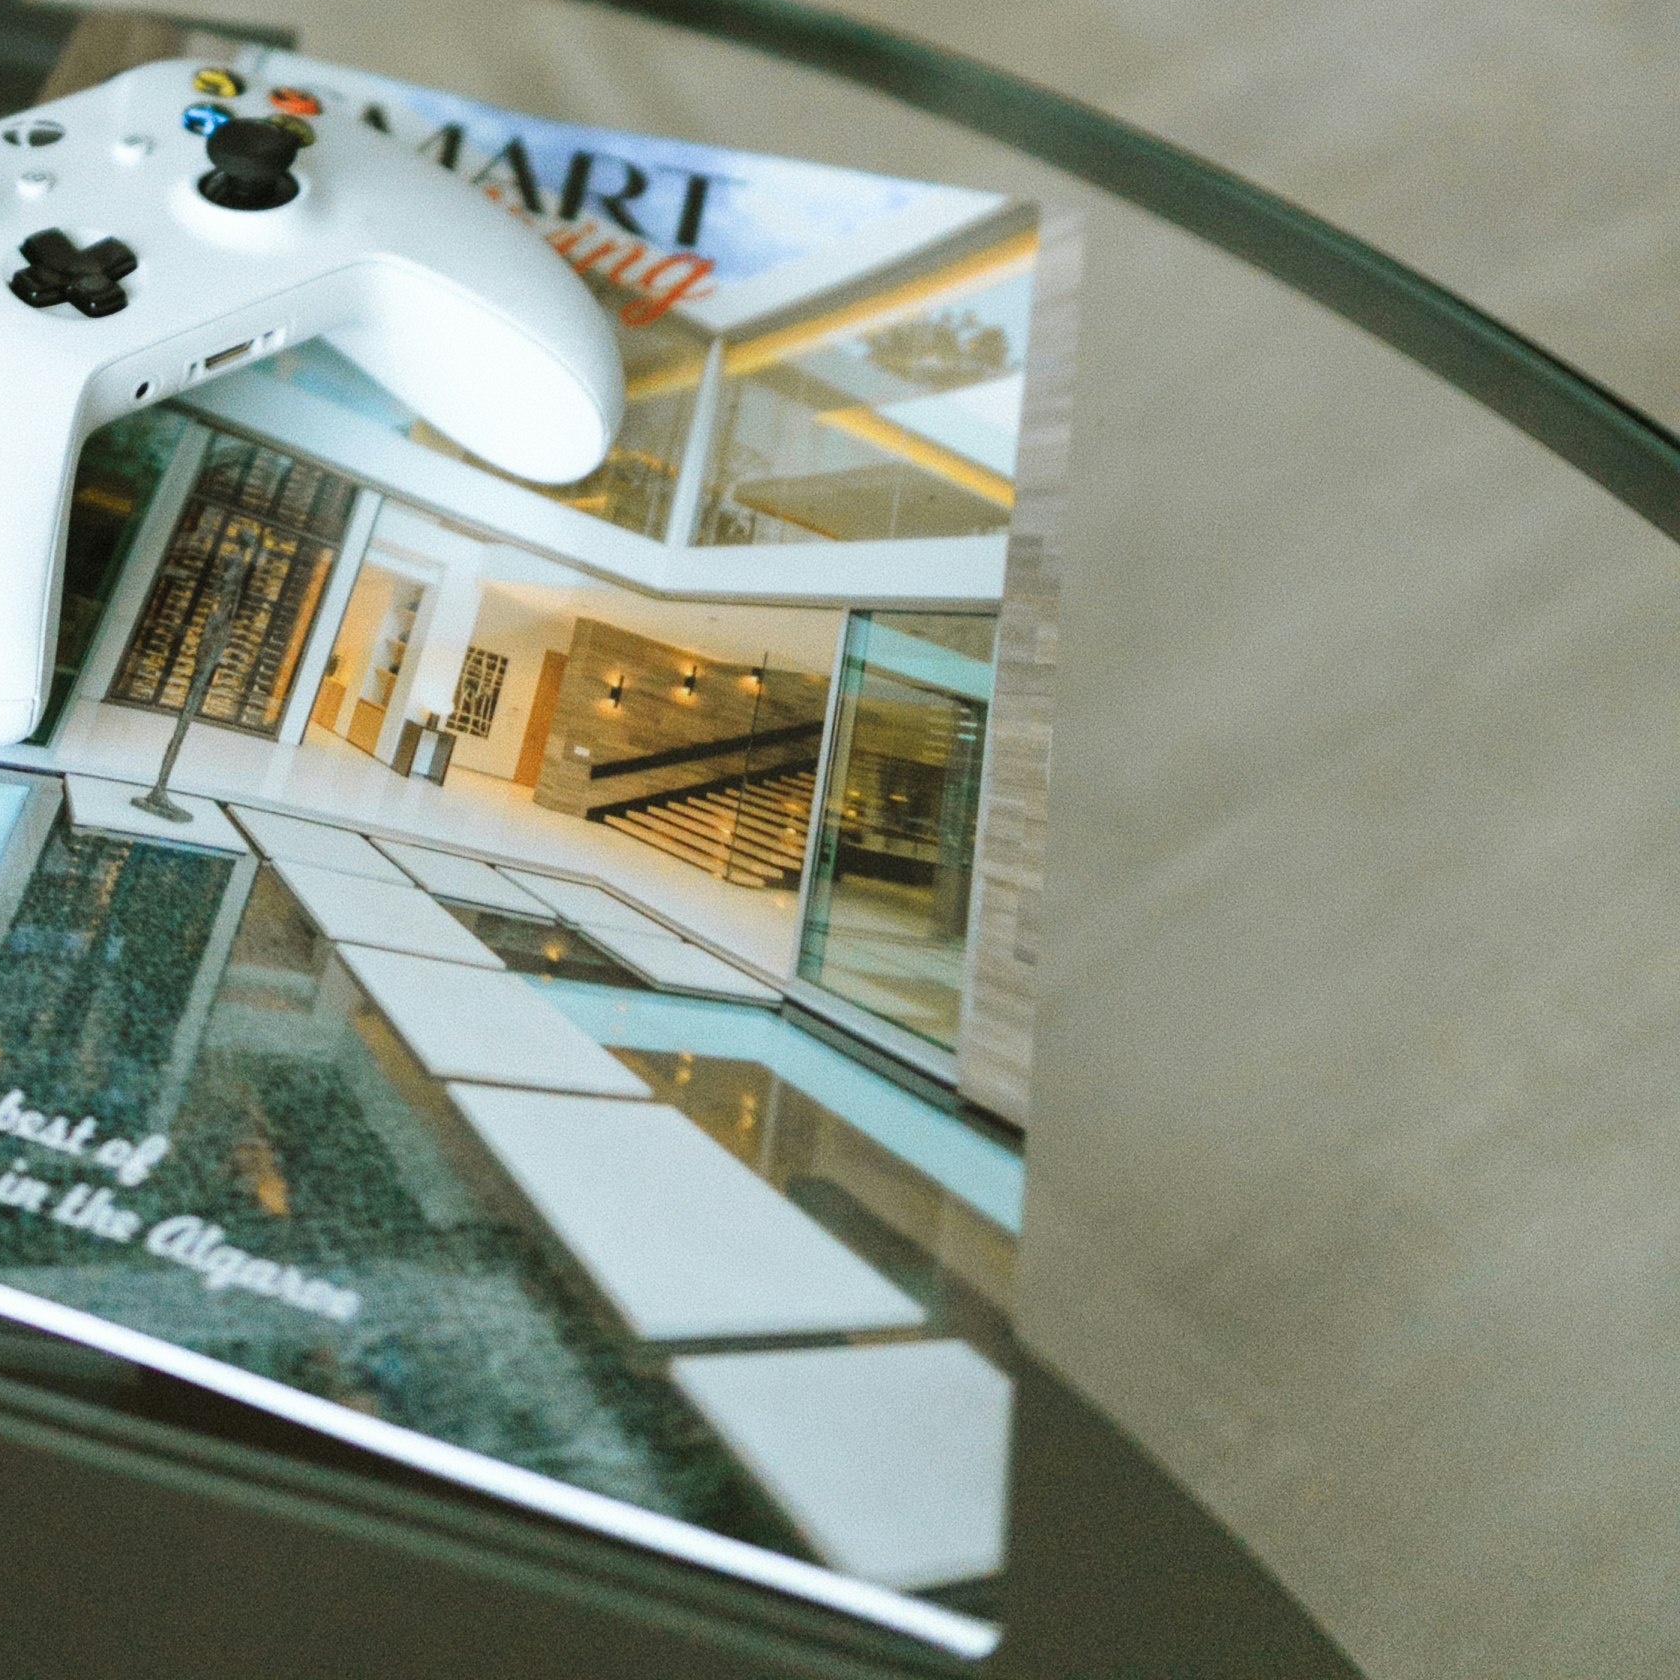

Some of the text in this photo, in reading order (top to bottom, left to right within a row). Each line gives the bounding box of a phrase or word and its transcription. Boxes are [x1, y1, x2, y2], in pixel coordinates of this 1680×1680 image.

[93, 1134, 170, 1188] of
[51, 1182, 142, 1243] the
[143, 1214, 362, 1326] Algarve
